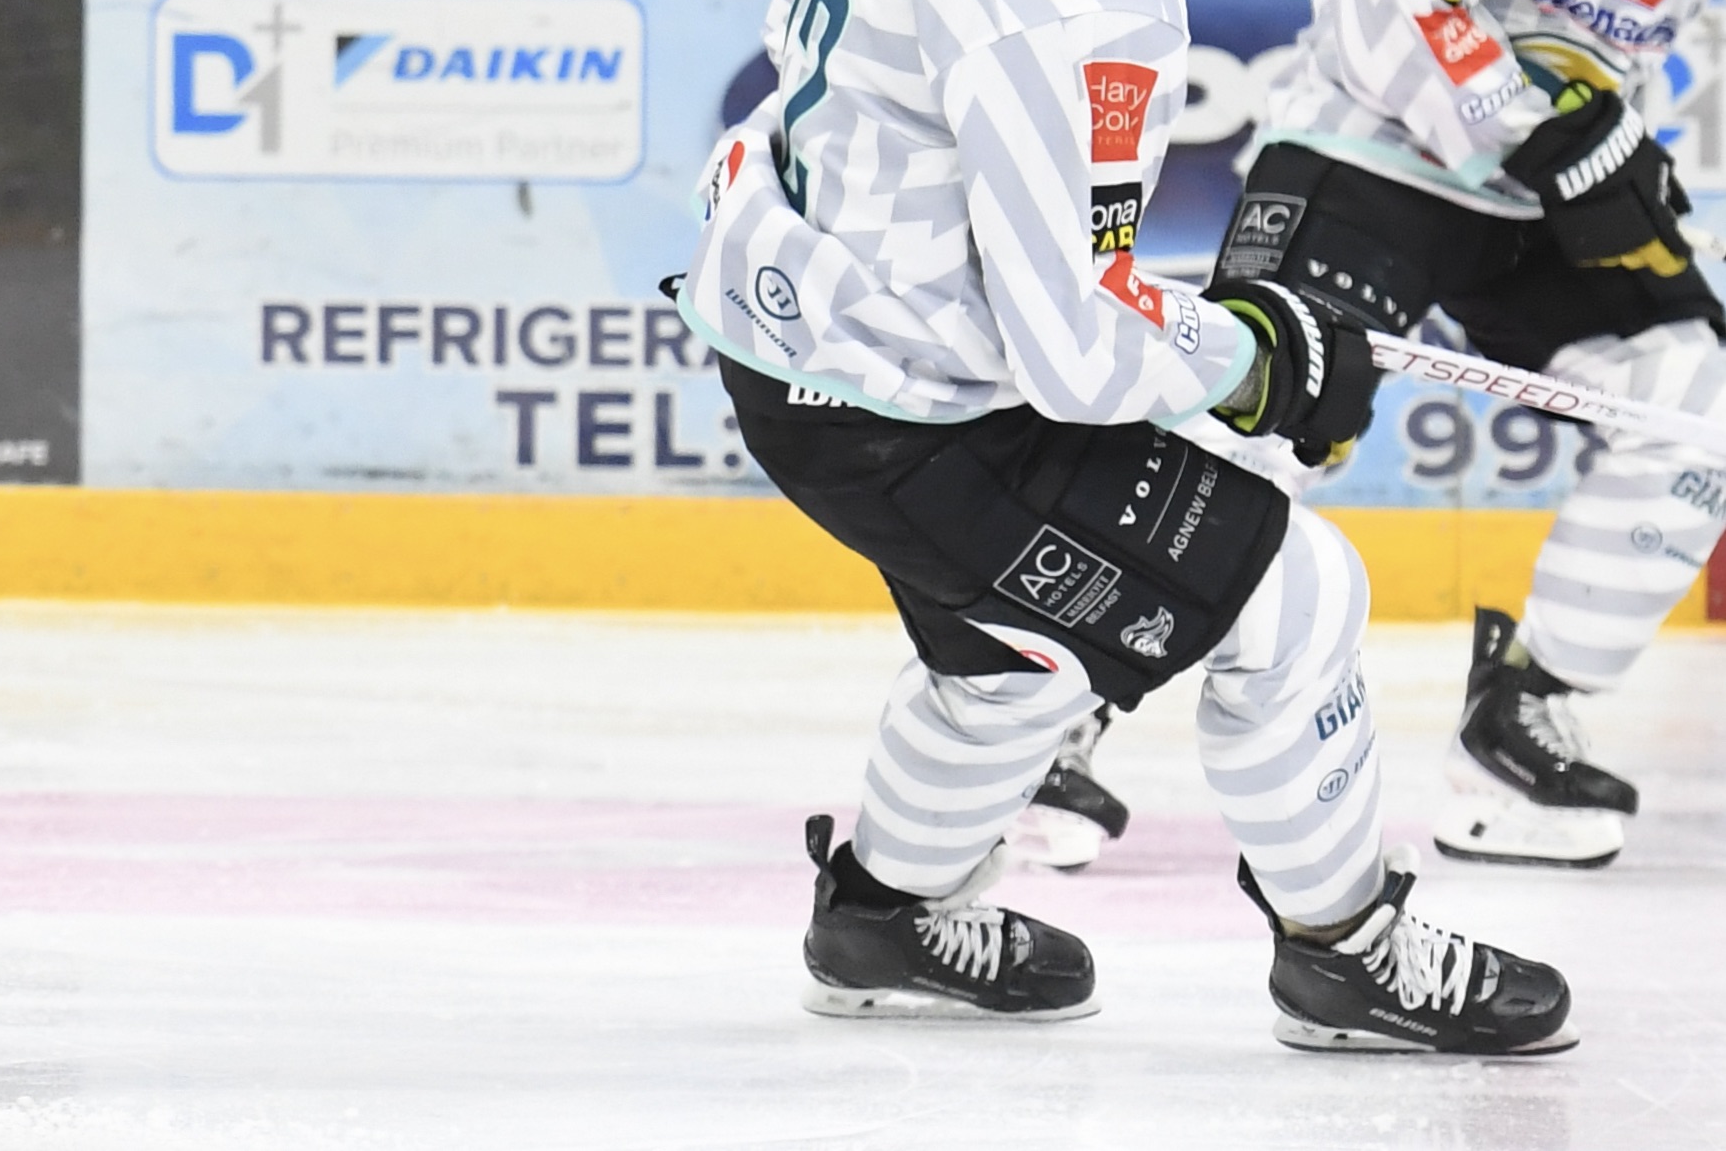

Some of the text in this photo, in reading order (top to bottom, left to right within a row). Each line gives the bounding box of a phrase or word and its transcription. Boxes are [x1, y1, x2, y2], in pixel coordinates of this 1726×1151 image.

[393, 46, 624, 83] DAIKIN
[1091, 200, 1137, 231] ona
[1241, 202, 1291, 235] AC
[261, 302, 720, 368] REFRIGER
[1371, 344, 1580, 413] ETSPEED
[495, 388, 742, 468] TEL:
[1118, 427, 1168, 526] VOLV
[1167, 454, 1220, 563] AGNEW BELF
[1019, 544, 1072, 601] AC
[1043, 560, 1089, 609] HOTELS
[1084, 587, 1123, 626] BELFAST
